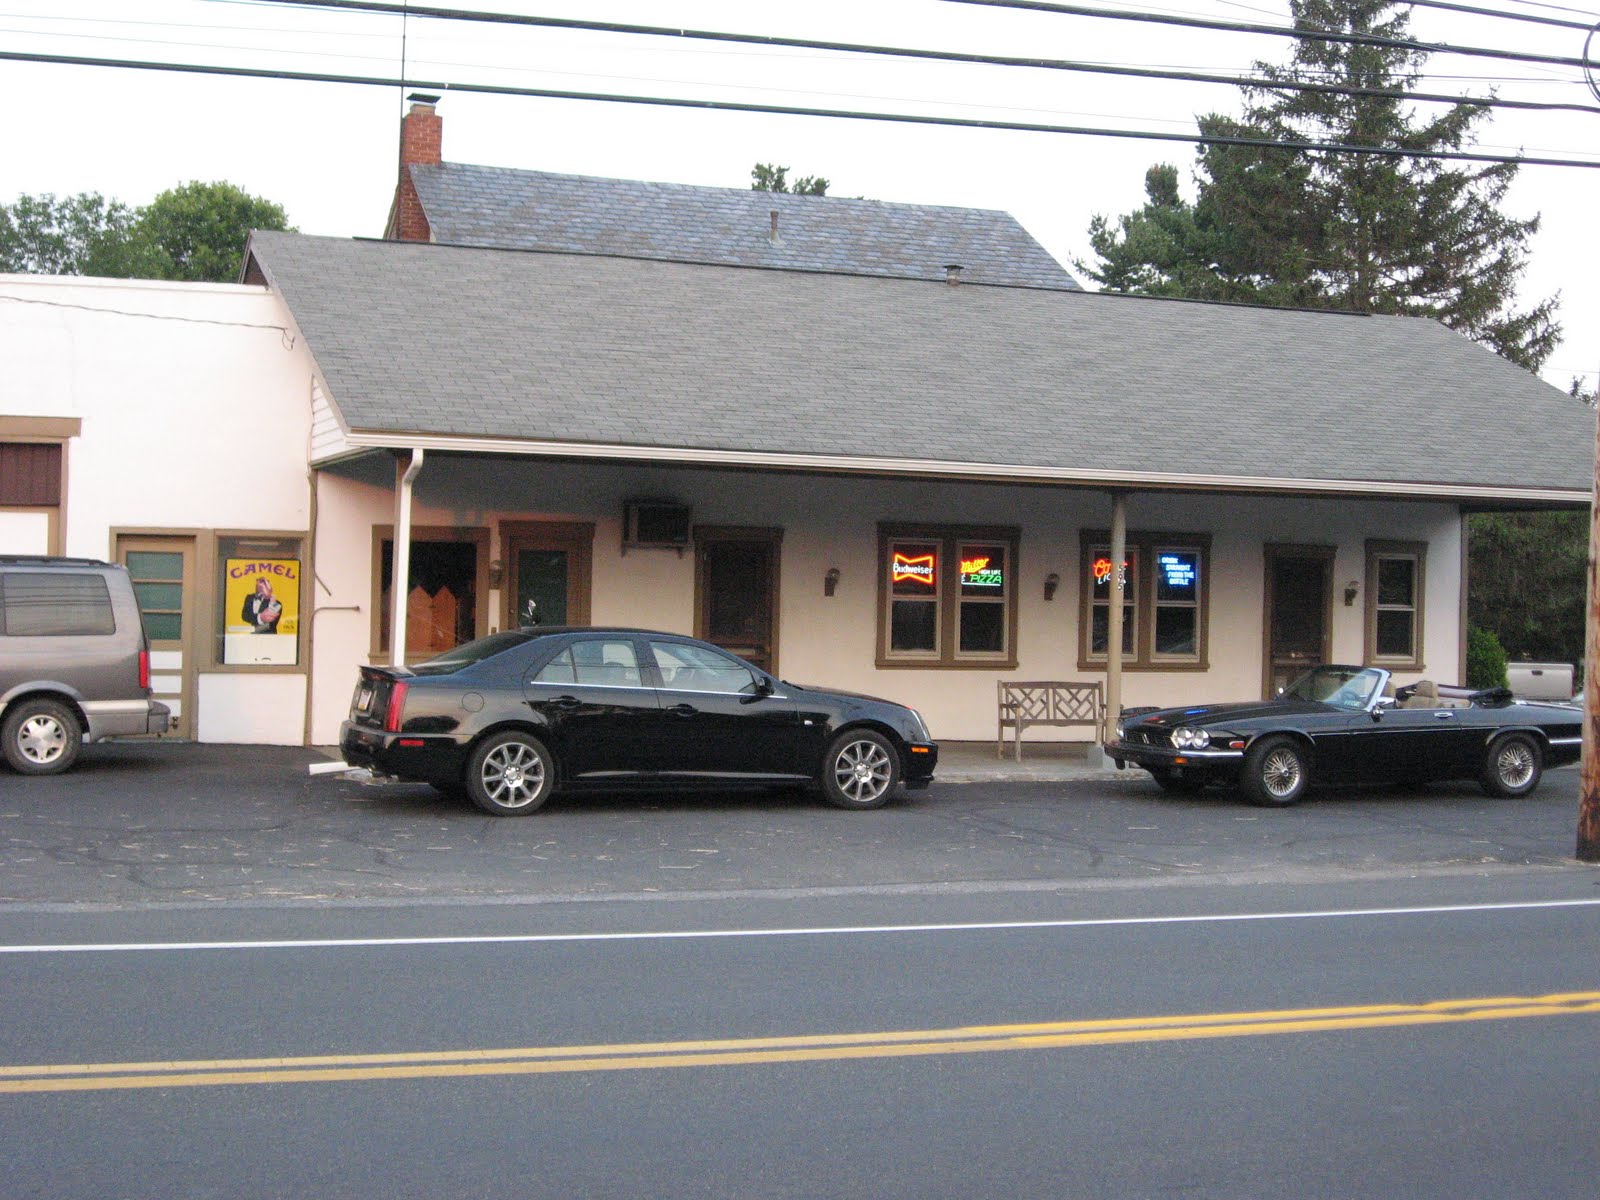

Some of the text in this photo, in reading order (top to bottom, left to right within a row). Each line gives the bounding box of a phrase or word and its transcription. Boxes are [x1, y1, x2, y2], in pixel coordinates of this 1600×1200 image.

[229, 562, 296, 579] CAMEL
[892, 562, 934, 575] Budweiser
[960, 557, 990, 573] Miller
[969, 574, 1002, 584] PIZZA
